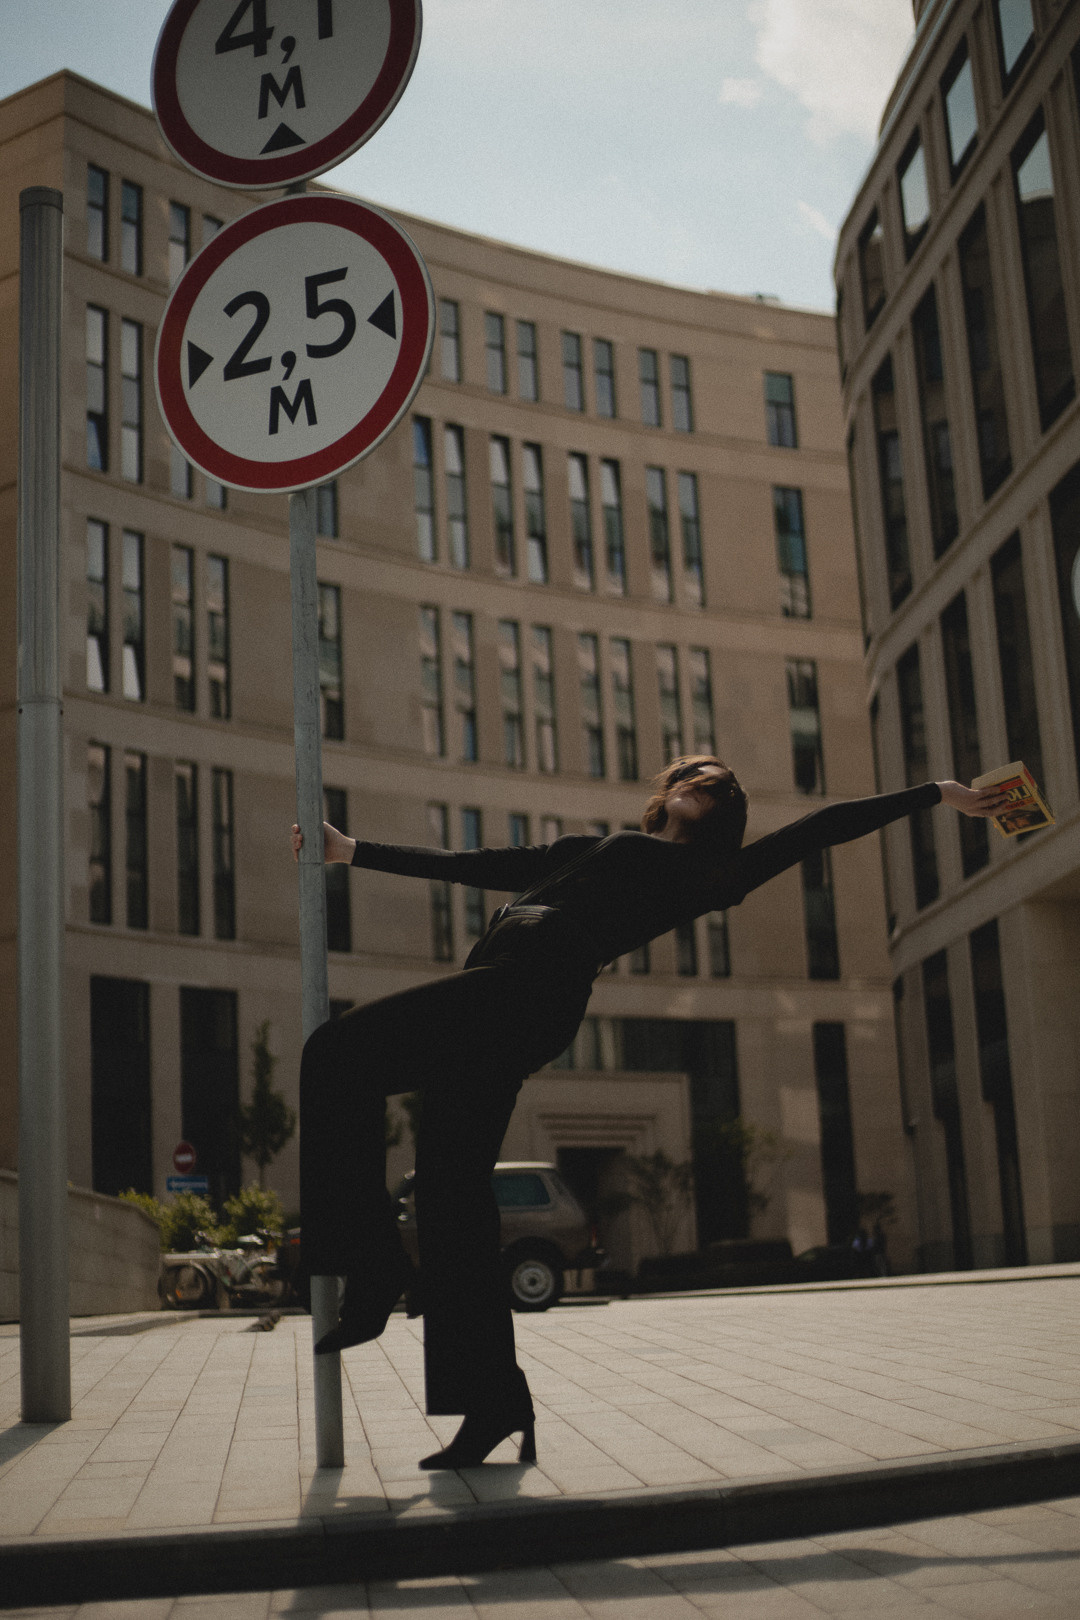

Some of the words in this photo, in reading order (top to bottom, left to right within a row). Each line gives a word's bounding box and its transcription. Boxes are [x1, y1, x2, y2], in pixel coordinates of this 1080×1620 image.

[258, 65, 306, 119] М
[223, 267, 357, 381] 2,5
[269, 378, 318, 435] М
